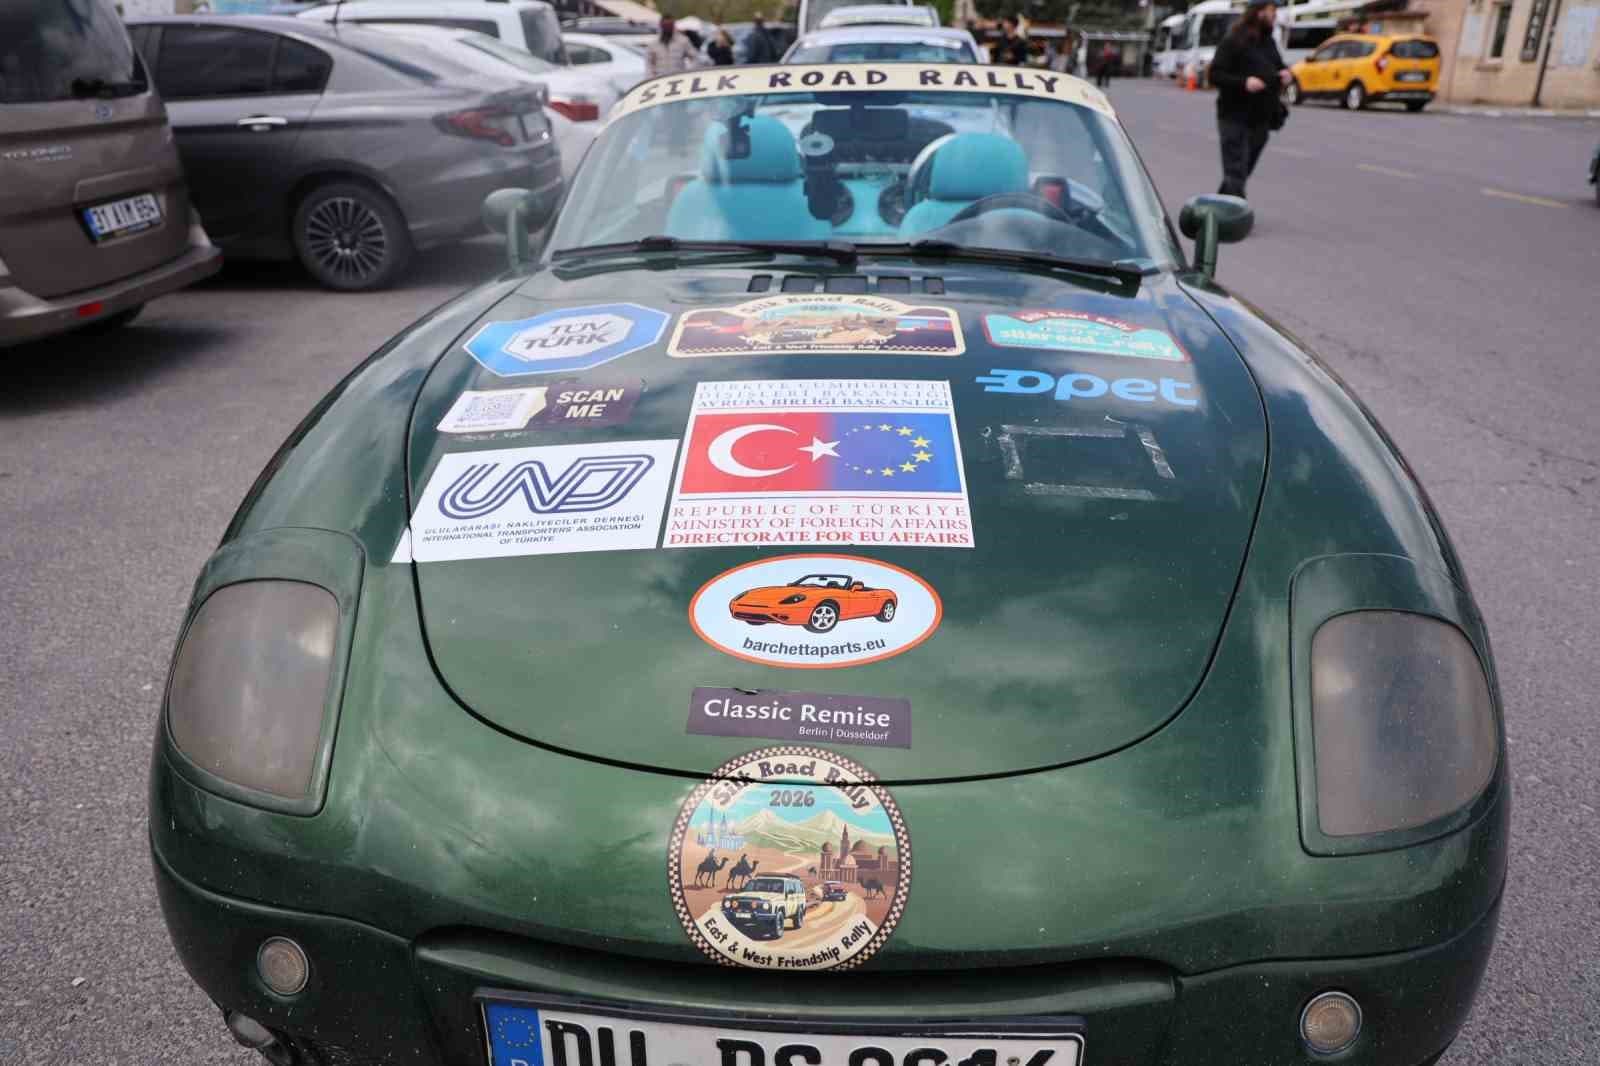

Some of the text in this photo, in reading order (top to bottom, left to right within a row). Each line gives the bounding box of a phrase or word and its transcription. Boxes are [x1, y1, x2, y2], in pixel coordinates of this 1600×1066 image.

[639, 70, 1059, 104] SILK ROAD RALLY
[556, 388, 625, 405] SCAN
[565, 403, 607, 419] ME
[438, 454, 656, 520] UND
[673, 504, 796, 517] REPUBLIC
[809, 504, 841, 515] OF
[672, 518, 969, 530] MINISTRY OF FOREIGN AFFAIRS
[669, 531, 970, 544] DIRECTORATE FOR EU AFFAIRS
[742, 636, 886, 658] barchettaparts.eu
[703, 698, 891, 727] Classic Remise
[799, 726, 828, 737] Berlin
[758, 760, 817, 778] Road
[769, 789, 815, 807] 2026
[703, 918, 873, 968] East & West Friendship Rally
